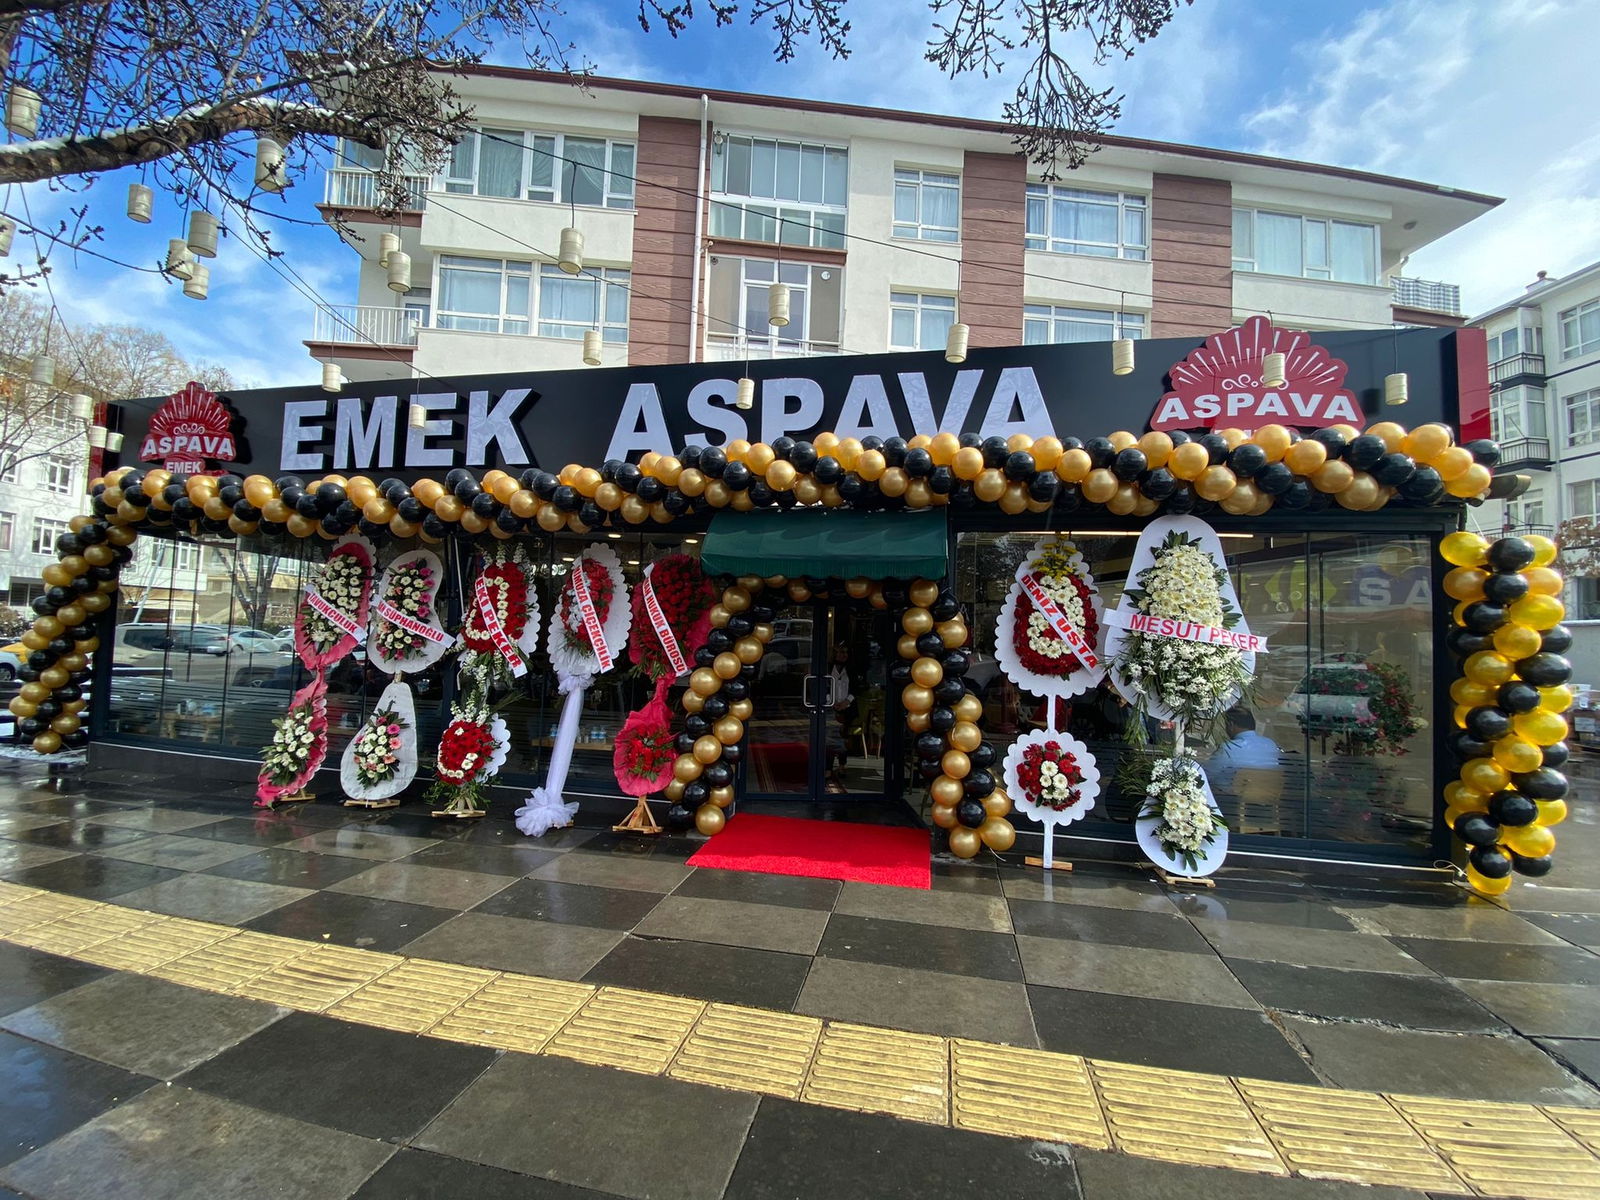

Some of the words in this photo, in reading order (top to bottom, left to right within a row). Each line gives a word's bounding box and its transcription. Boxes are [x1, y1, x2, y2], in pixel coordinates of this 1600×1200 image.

[280, 388, 531, 471] EMEK
[603, 367, 1057, 464] ASPAVA
[1156, 392, 1359, 424] ASPAVA
[141, 435, 234, 457] ASPAVA
[165, 461, 203, 474] EMEK
[383, 606, 445, 642] SÜPHANOĞLU
[483, 609, 522, 668] PEKER
[1021, 575, 1059, 617] DENİZ
[1056, 617, 1098, 668] USTA
[1130, 614, 1206, 640] MESUT
[1209, 627, 1259, 651] PEKER
[660, 629, 686, 672] BÜROSU
